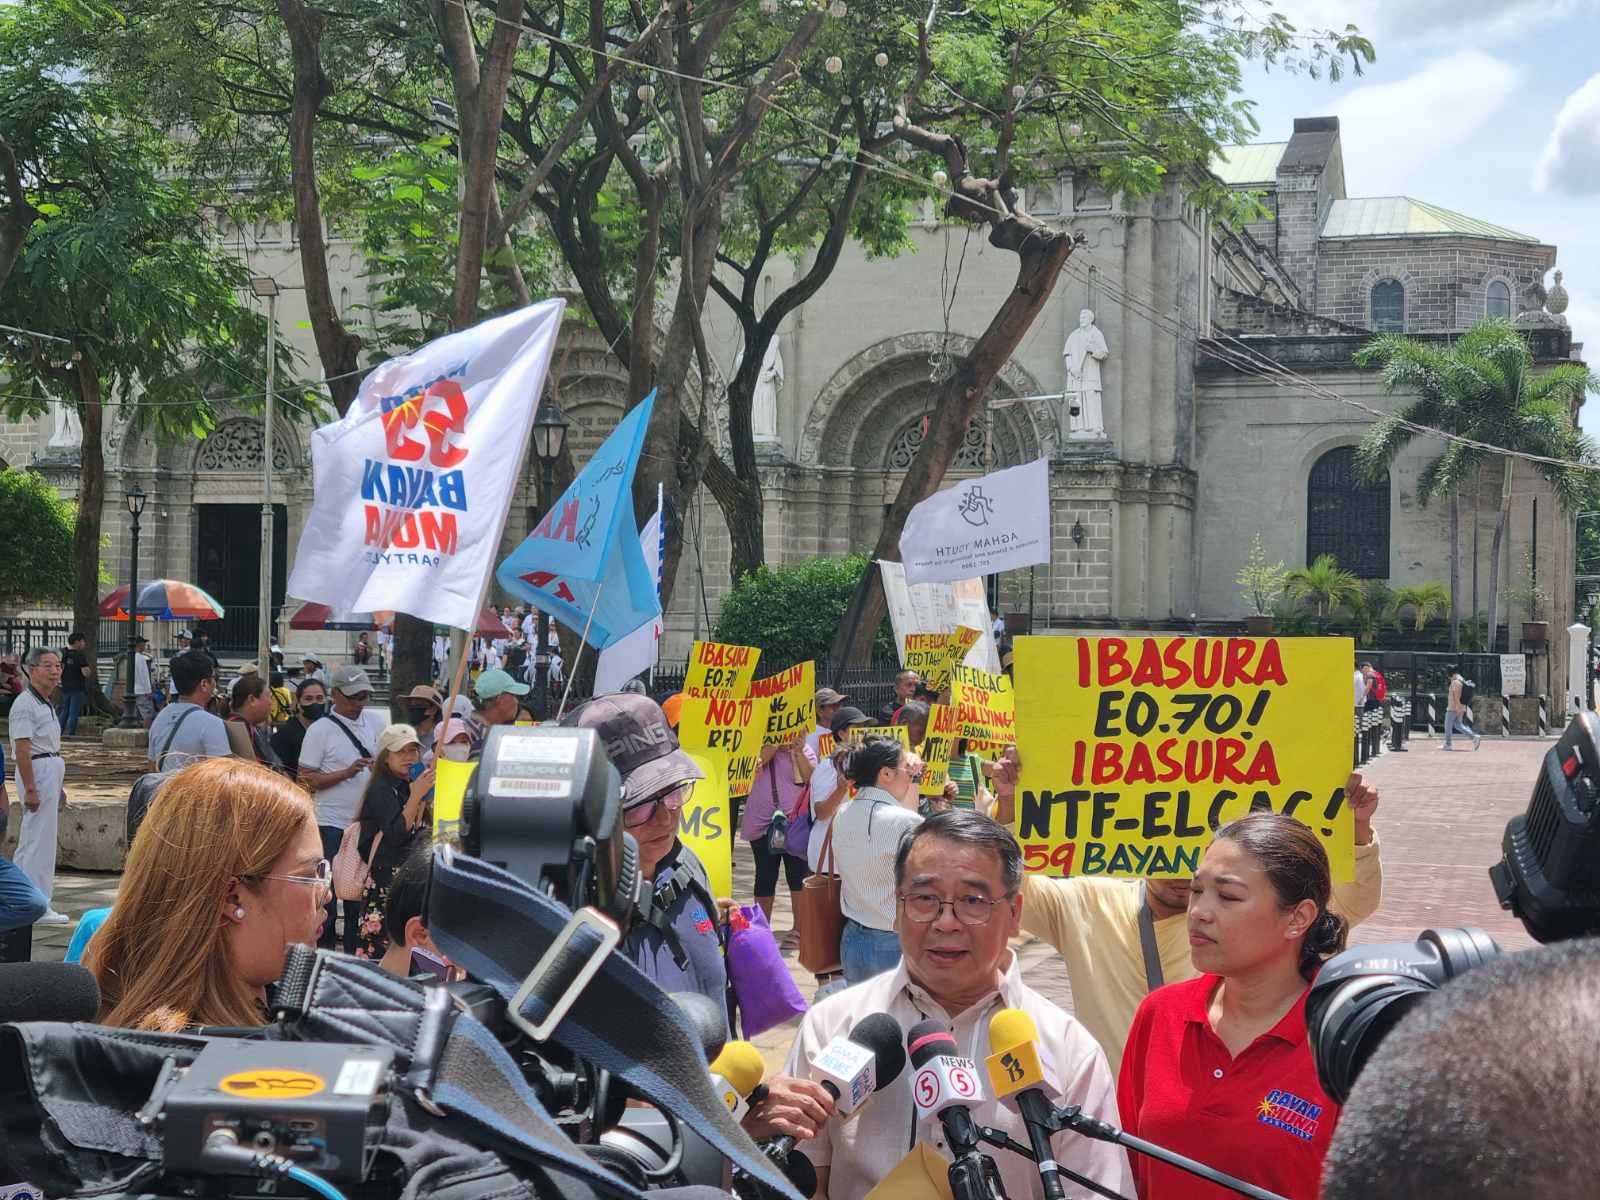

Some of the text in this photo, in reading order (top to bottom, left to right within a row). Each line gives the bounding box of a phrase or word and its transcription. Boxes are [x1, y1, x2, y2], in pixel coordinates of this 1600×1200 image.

[698, 641, 752, 667] IBASURA
[1077, 637, 1288, 689] IBASURA
[961, 685, 991, 706] STOP
[704, 697, 753, 728] NO TO
[1094, 689, 1271, 739] EO.70!
[963, 724, 992, 738] BAYAN
[1071, 737, 1281, 786] IBASURA
[1022, 841, 1200, 877] 59 BAYAN
[940, 1056, 975, 1070] NEWS
[919, 1076, 934, 1102] 5
[955, 1073, 970, 1093] 5
